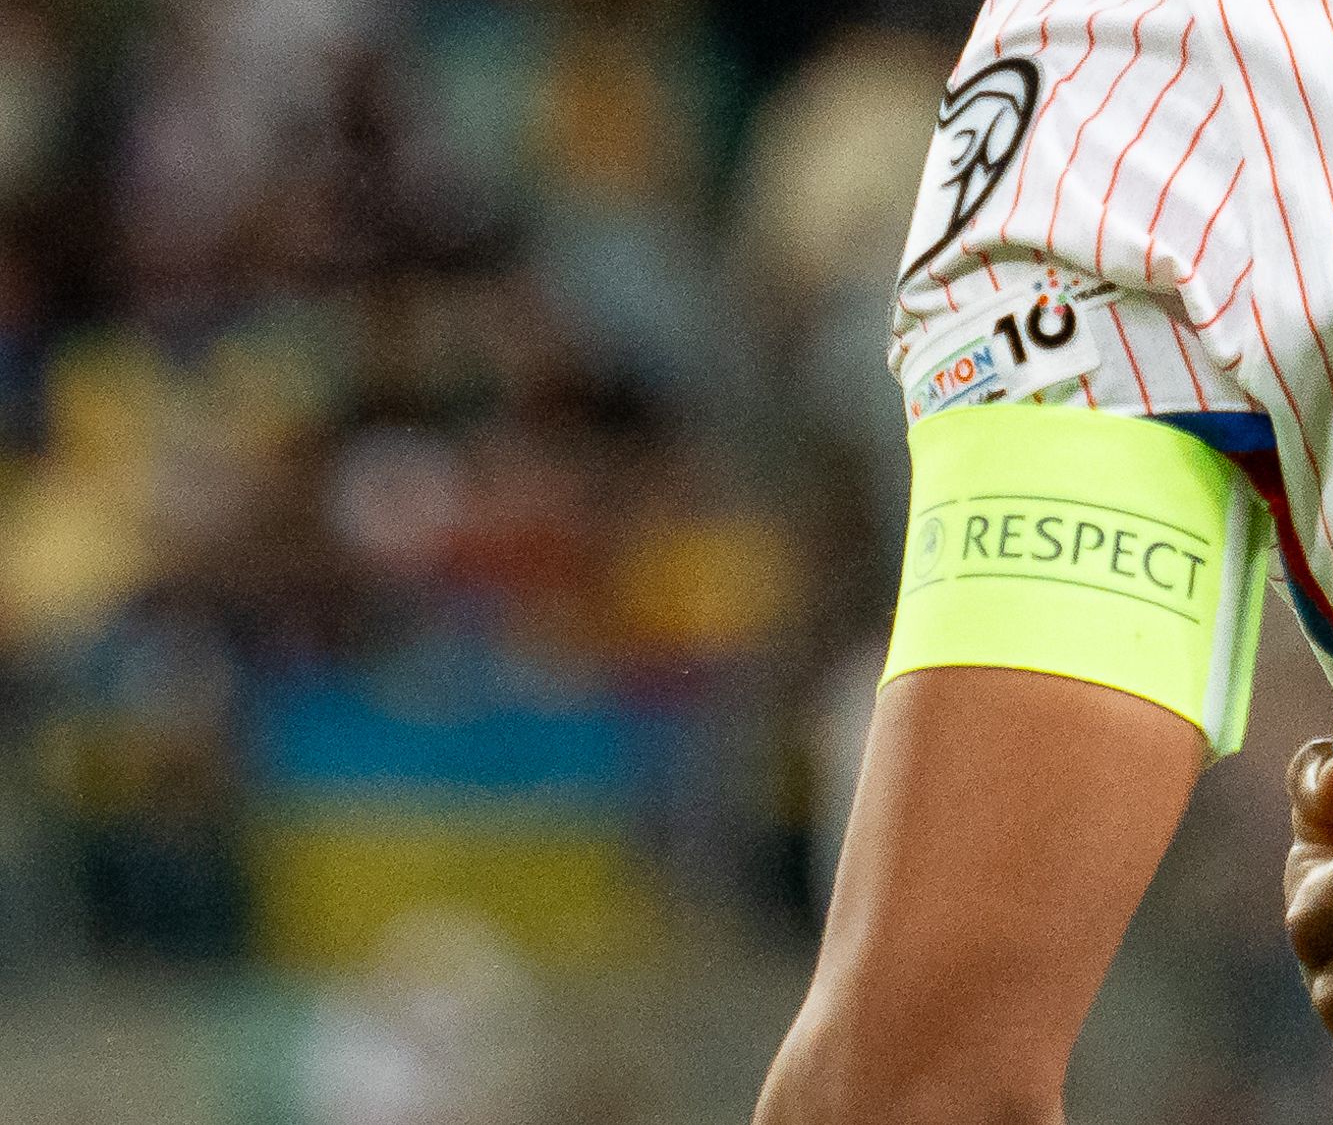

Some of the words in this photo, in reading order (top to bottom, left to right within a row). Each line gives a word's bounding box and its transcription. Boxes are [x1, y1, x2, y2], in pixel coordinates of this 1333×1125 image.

[993, 295, 1078, 365] 10
[911, 345, 995, 420] ATION
[962, 514, 1207, 599] RESPECT
